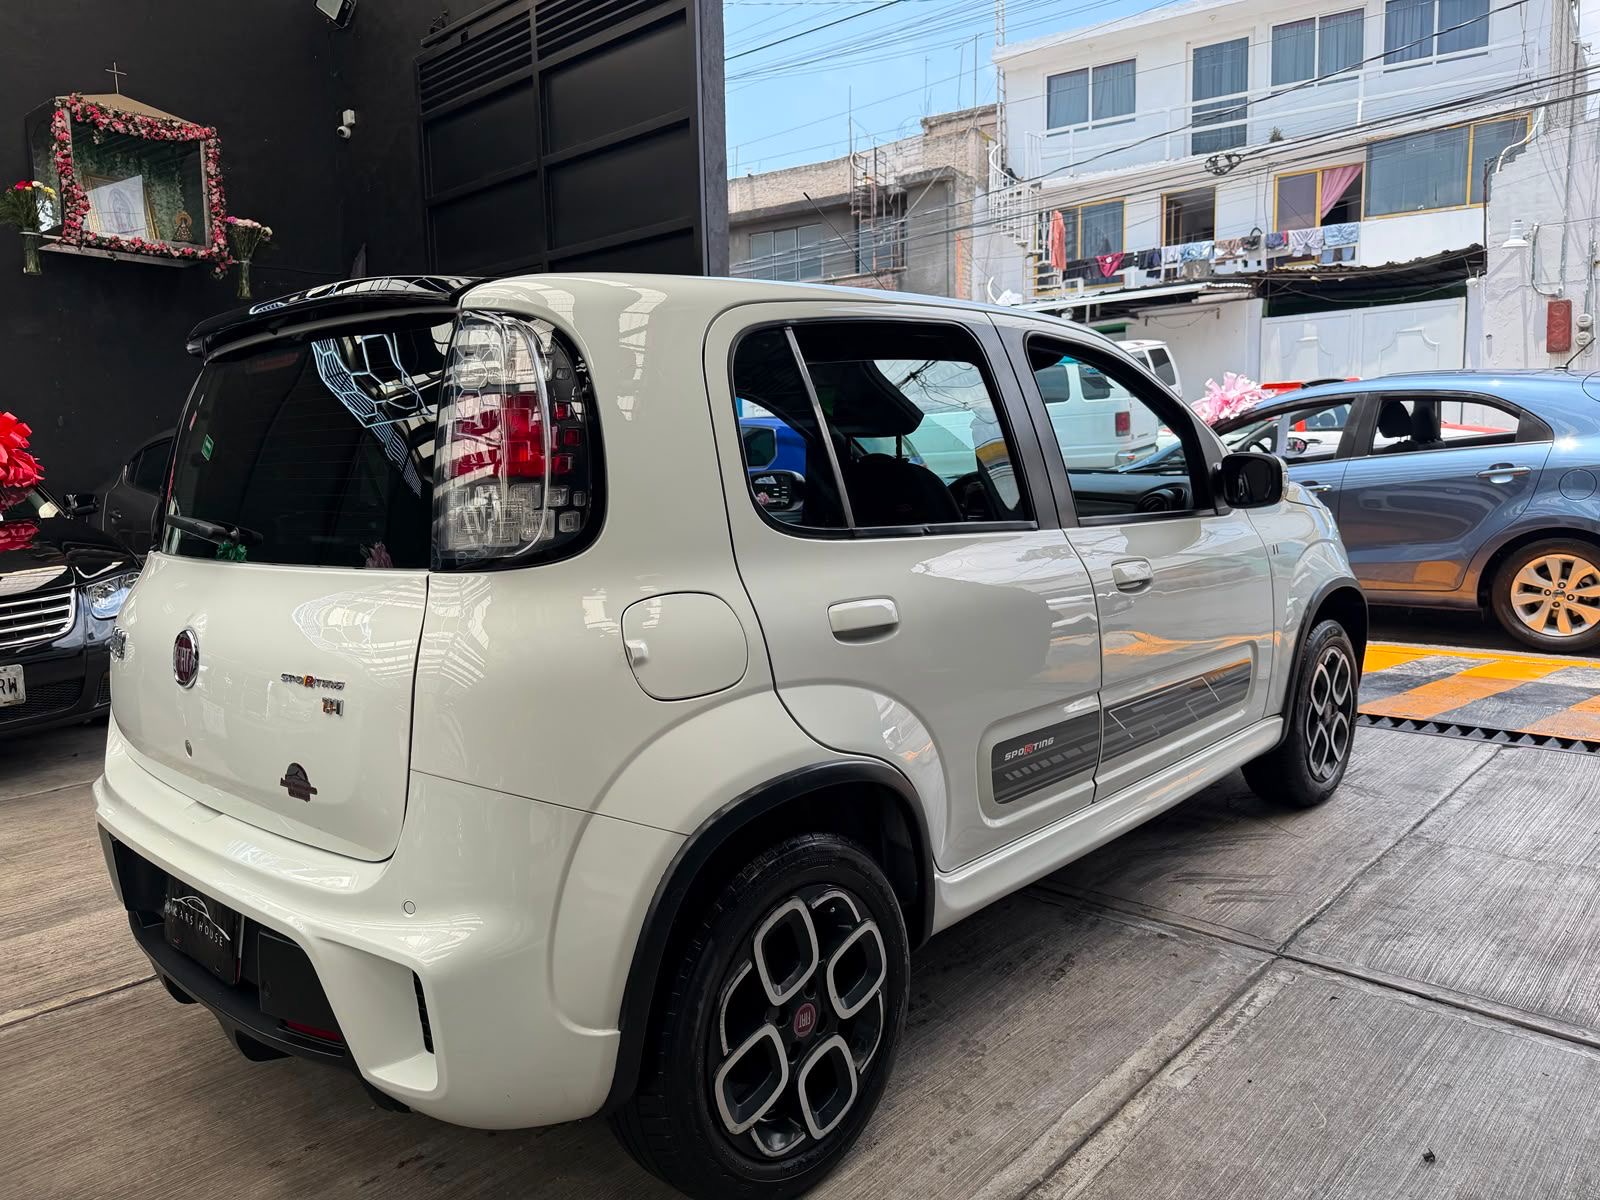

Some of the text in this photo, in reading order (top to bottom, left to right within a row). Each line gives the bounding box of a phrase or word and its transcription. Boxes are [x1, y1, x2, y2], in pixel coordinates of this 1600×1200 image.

[280, 672, 345, 690] SPORTING
[1004, 737, 1055, 761] SPORTING
[198, 920, 223, 947] HOUSE
[798, 1010, 811, 1028] FIAT
